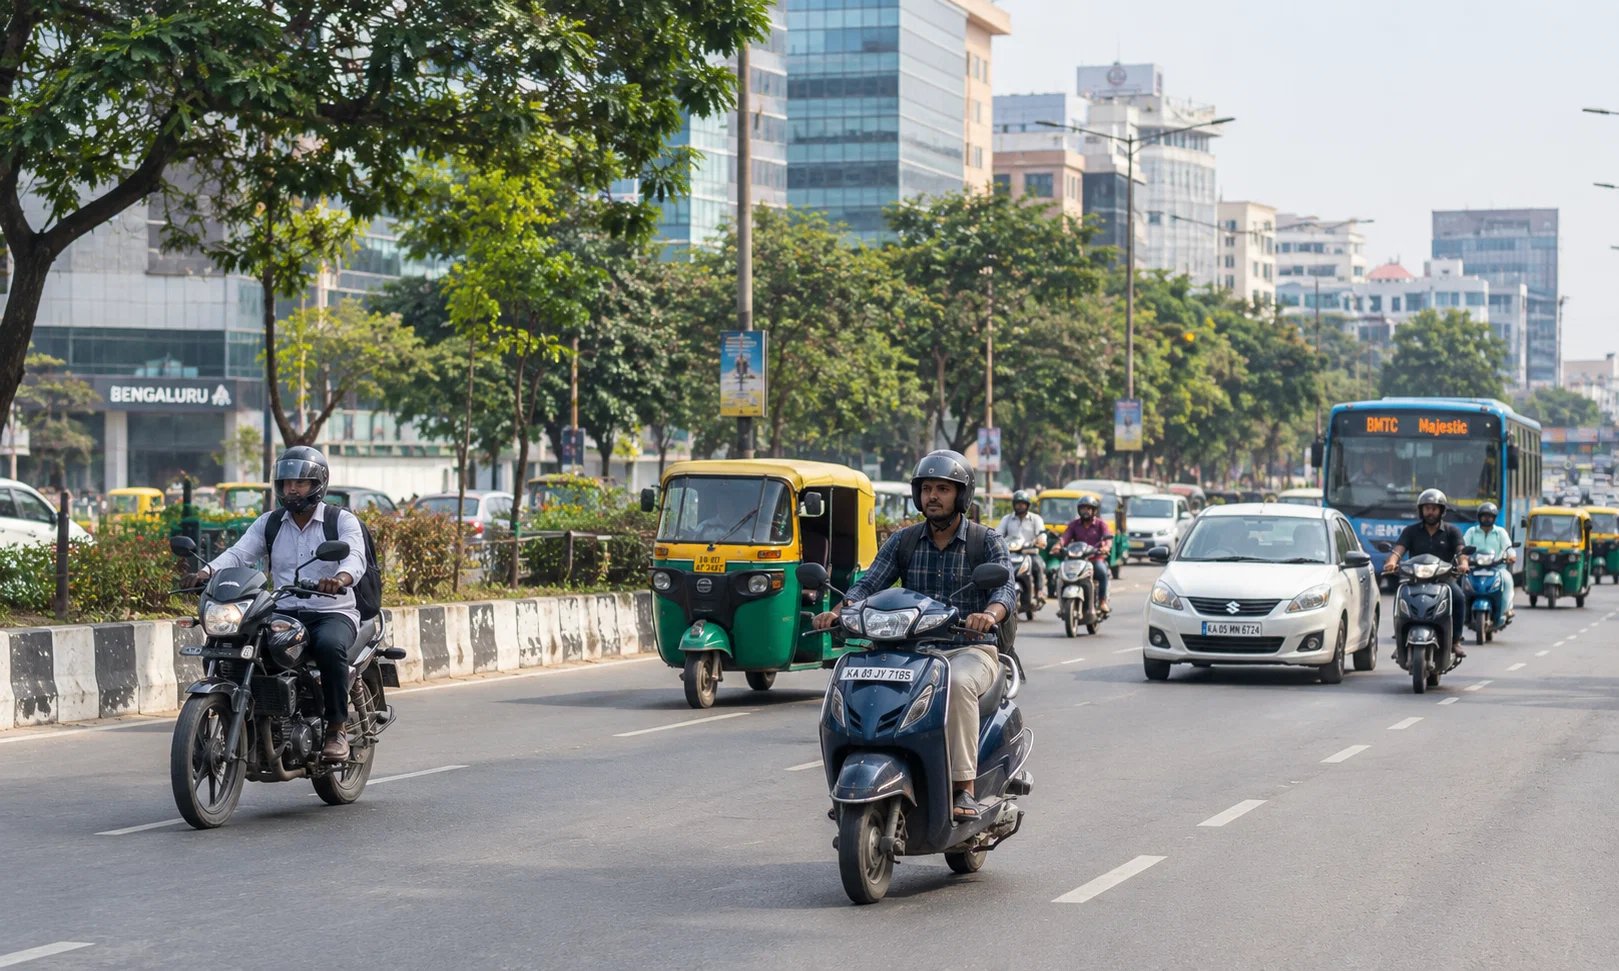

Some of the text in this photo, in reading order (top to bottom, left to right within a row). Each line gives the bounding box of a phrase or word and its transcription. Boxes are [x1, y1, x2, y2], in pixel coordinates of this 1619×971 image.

[110, 385, 208, 403] BENGALURU
[1366, 417, 1467, 436] BMTC Majestic
[1241, 625, 1260, 635] 6724
[846, 669, 859, 678] KA
[874, 669, 886, 678] JY
